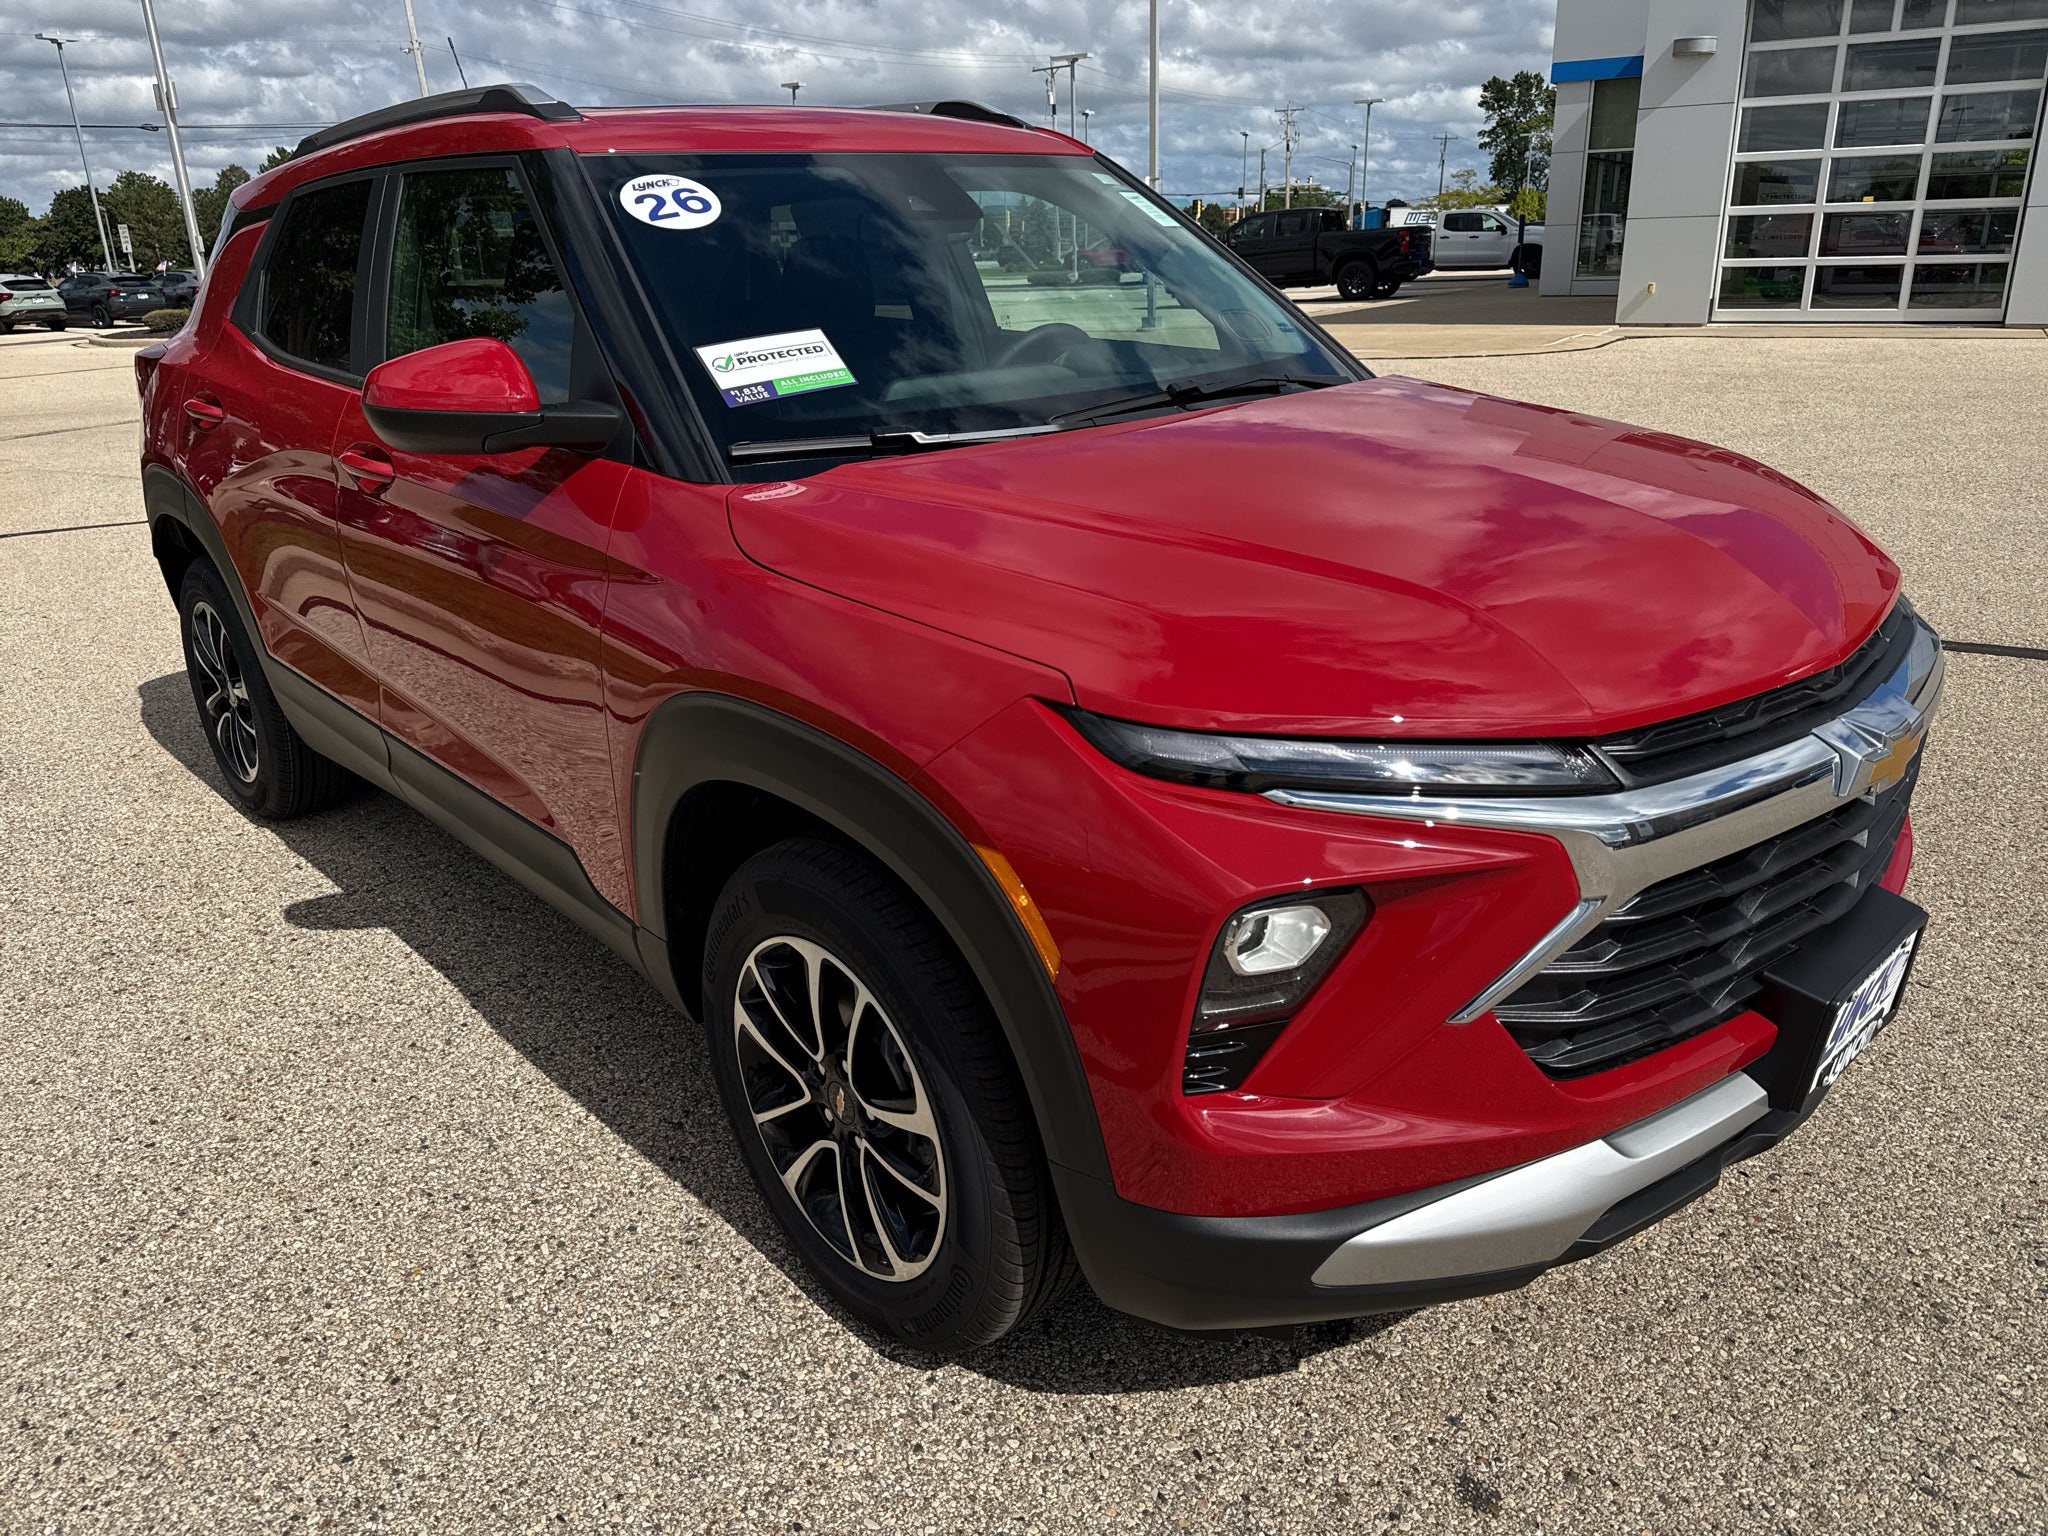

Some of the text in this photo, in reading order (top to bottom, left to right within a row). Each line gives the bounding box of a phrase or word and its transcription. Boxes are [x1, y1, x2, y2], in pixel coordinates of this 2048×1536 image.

[632, 179, 670, 192] LYNCH
[634, 188, 713, 222] 26
[736, 345, 824, 365] PROTECTED
[781, 379, 798, 387] ALL
[799, 371, 846, 383] INCLUDED
[730, 385, 765, 397] $1,836
[735, 391, 771, 403] VALUE
